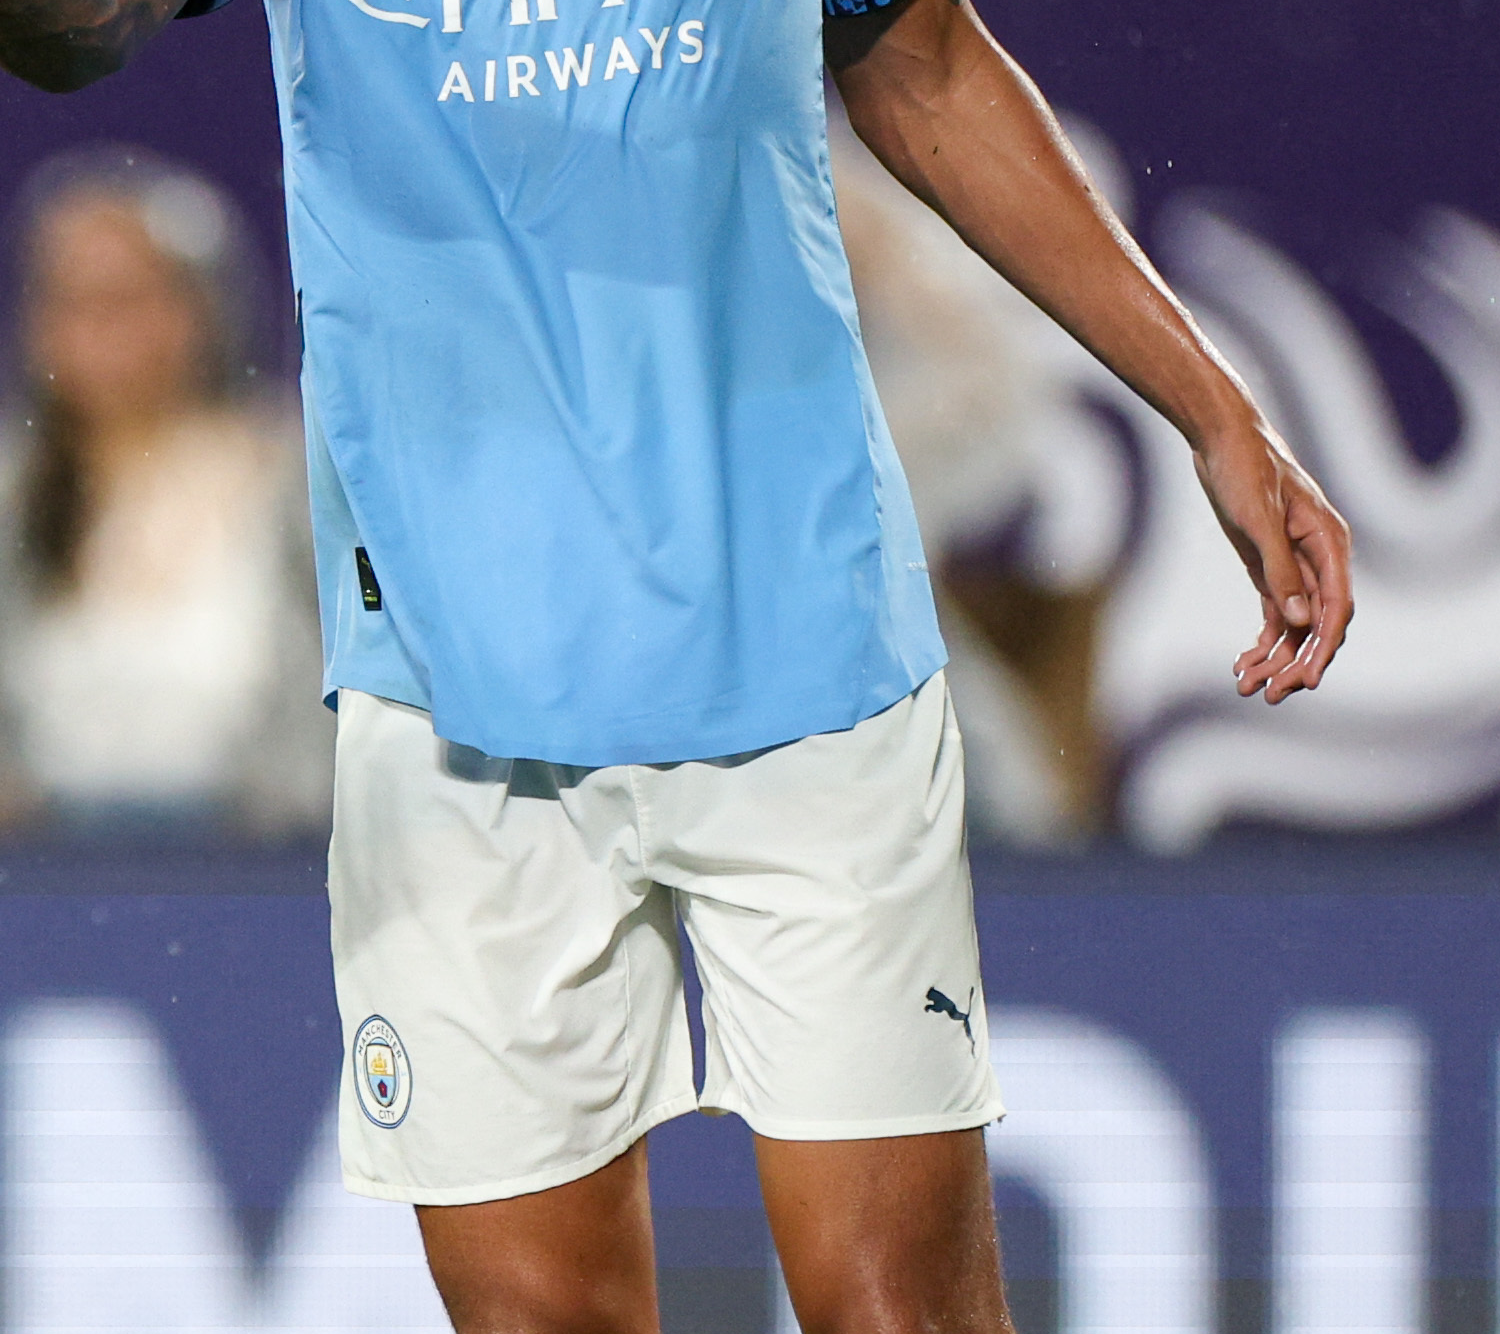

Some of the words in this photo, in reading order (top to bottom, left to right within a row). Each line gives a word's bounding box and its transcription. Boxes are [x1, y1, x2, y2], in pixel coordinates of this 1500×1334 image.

[437, 20, 705, 103] AIRWAYS
[358, 1024, 402, 1058] MANCHESTER
[379, 1109, 396, 1121] CITY
